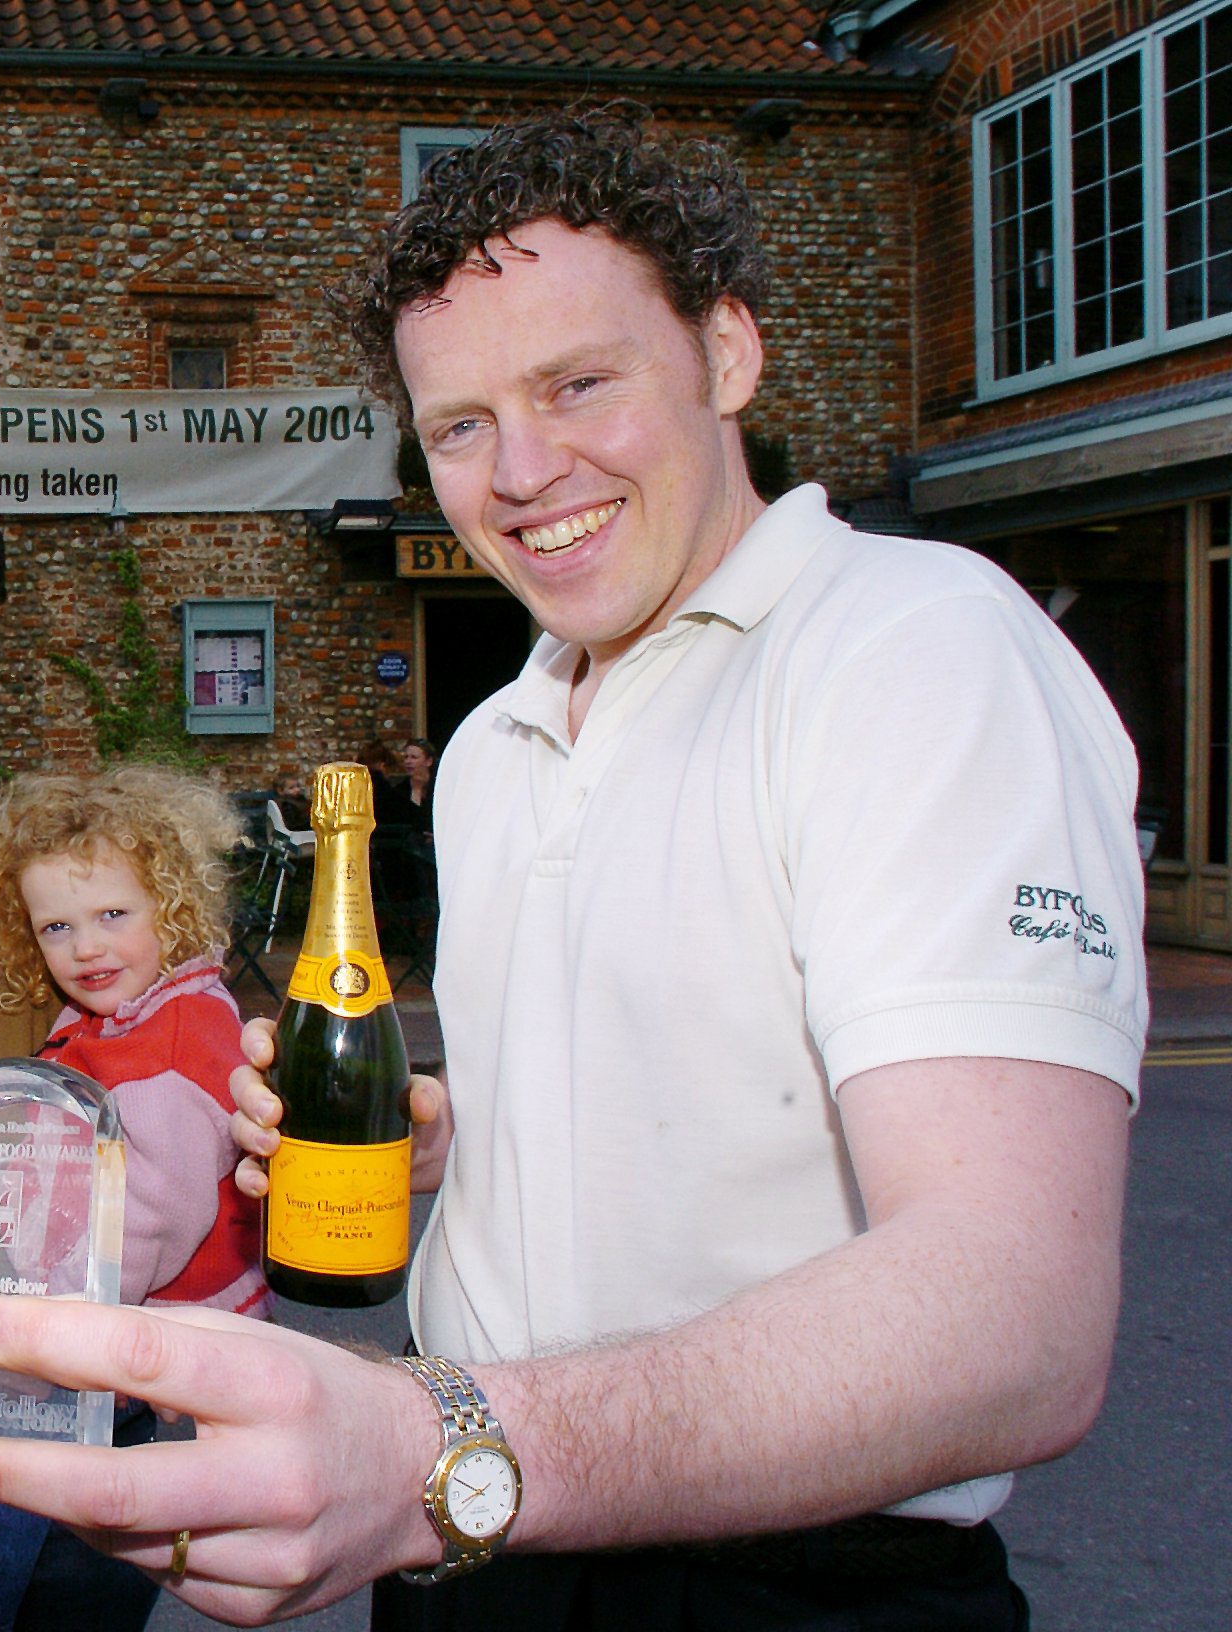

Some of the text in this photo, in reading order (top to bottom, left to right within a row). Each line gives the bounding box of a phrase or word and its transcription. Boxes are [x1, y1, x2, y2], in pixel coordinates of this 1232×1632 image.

[121, 408, 168, 443] 1st
[183, 407, 268, 443] MAY
[284, 405, 375, 443] 2004
[41, 467, 118, 497] taken
[317, 1199, 363, 1216] Clicquot
[326, 1231, 374, 1239] FRANCE
